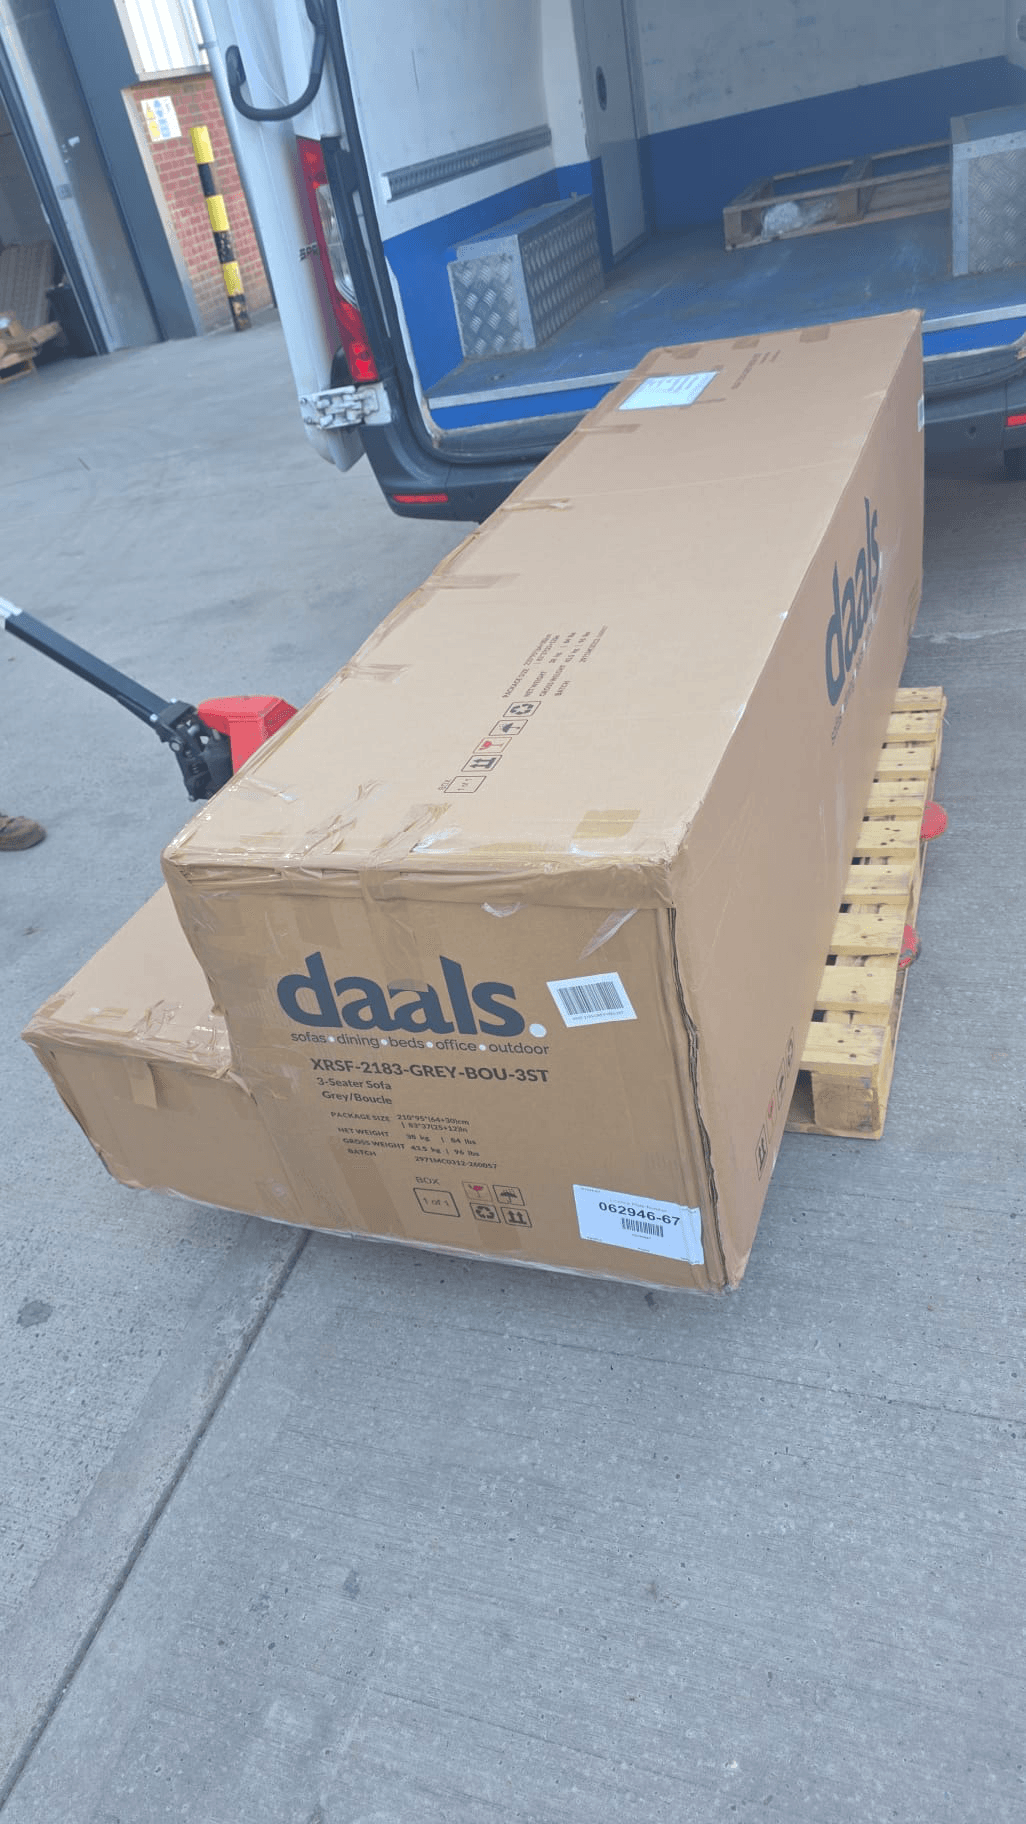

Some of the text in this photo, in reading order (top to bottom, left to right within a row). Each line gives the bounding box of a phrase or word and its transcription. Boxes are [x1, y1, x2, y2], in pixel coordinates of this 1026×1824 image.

[310, 1058, 549, 1082] XRSF-2183-GREY-BOU-3ST
[316, 1077, 392, 1090] 3-Seater Sofa
[321, 1090, 393, 1105] Grey/Boucle
[330, 1111, 371, 1121] PACKAGE
[355, 1128, 389, 1137] WEIGHT
[342, 1137, 371, 1146] GROSS
[372, 1140, 405, 1149] WEIGHT
[415, 1176, 440, 1185] BOX
[599, 1201, 680, 1226] 062946-67
